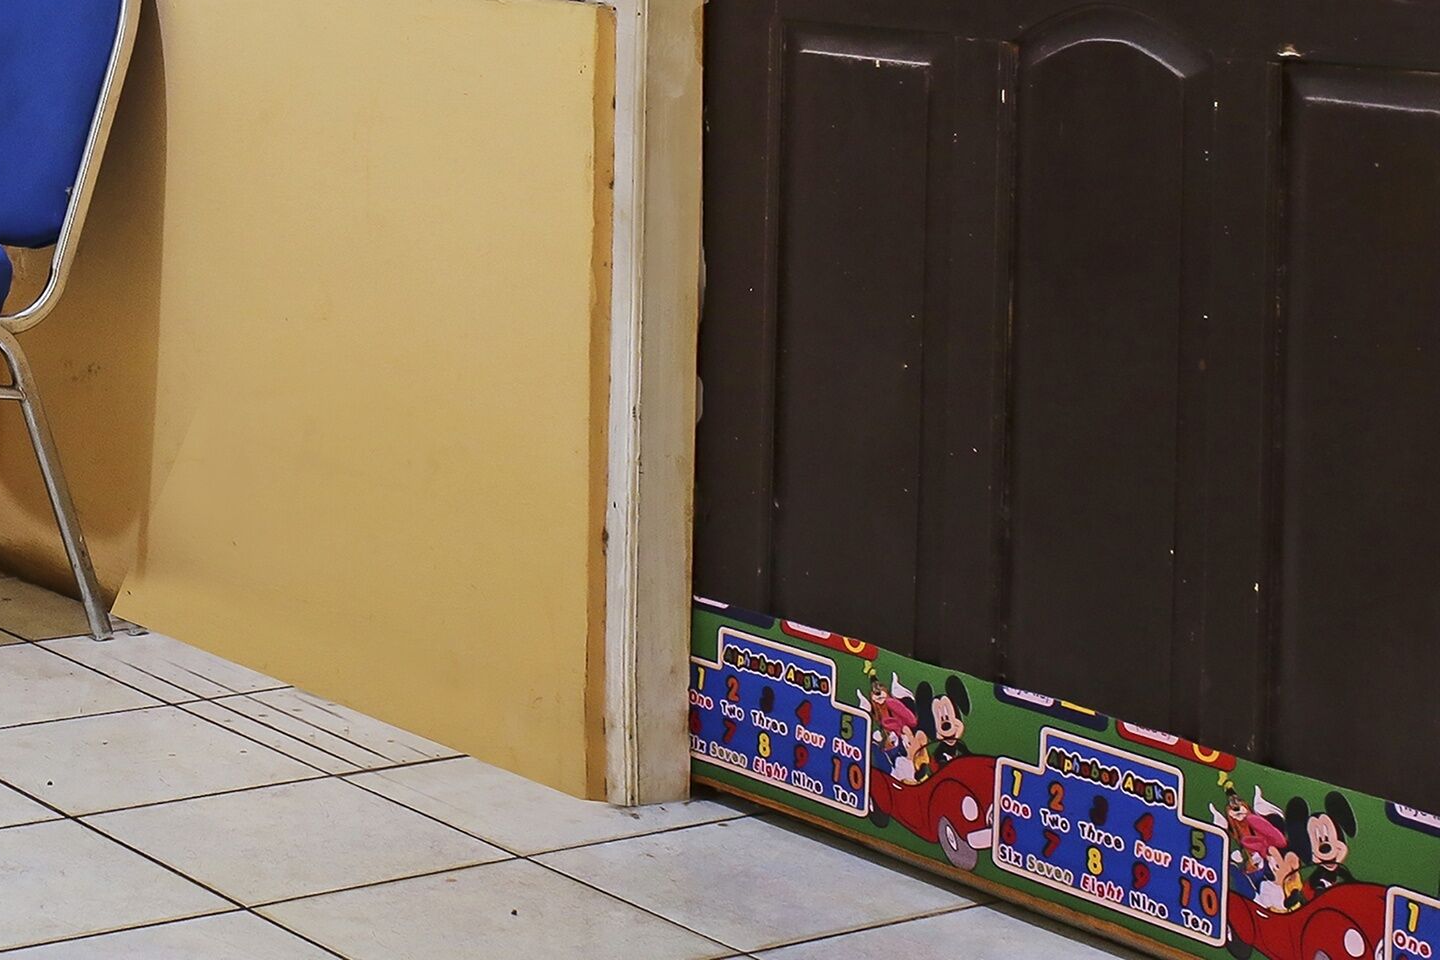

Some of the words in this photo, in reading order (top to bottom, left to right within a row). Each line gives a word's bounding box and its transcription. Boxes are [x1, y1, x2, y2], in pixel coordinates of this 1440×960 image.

[696, 666, 706, 690] 1
[726, 676, 740, 702] 2
[840, 714, 853, 740] 5
[723, 644, 783, 681] Alphabet
[785, 664, 831, 696] Angka
[689, 689, 714, 710] One
[720, 700, 745, 721] Two
[751, 710, 788, 736] Three
[795, 724, 826, 749] Four
[832, 738, 862, 761] Five
[723, 719, 737, 743] 7
[758, 732, 772, 758] 8
[794, 744, 809, 769] 9
[832, 756, 864, 790] 10
[709, 741, 748, 768] Seven
[752, 757, 788, 781] Eight
[791, 770, 824, 795] Nine
[832, 785, 858, 808] Ten
[1047, 747, 1120, 788] Alphabet
[1122, 771, 1177, 809] Angka
[1000, 795, 1032, 819] One
[1040, 808, 1071, 832] Two
[1078, 820, 1125, 851] Three
[1134, 840, 1172, 867] Four
[1180, 856, 1217, 883] Five
[1012, 769, 1022, 797] 1
[1048, 781, 1064, 811] 2
[1134, 812, 1154, 841] 4
[1190, 829, 1207, 860] 5
[998, 844, 1022, 867] Six
[1026, 853, 1074, 886] Seven
[1080, 873, 1124, 901] Eight
[1129, 891, 1169, 919] Nine
[1181, 910, 1213, 936] Ten
[1001, 816, 1017, 845] 6
[1042, 831, 1060, 857] 7
[1087, 846, 1103, 875] 8
[1132, 861, 1151, 889] 9
[1180, 877, 1219, 917] 10
[1392, 929, 1432, 958] One
[1407, 901, 1420, 933] 1
